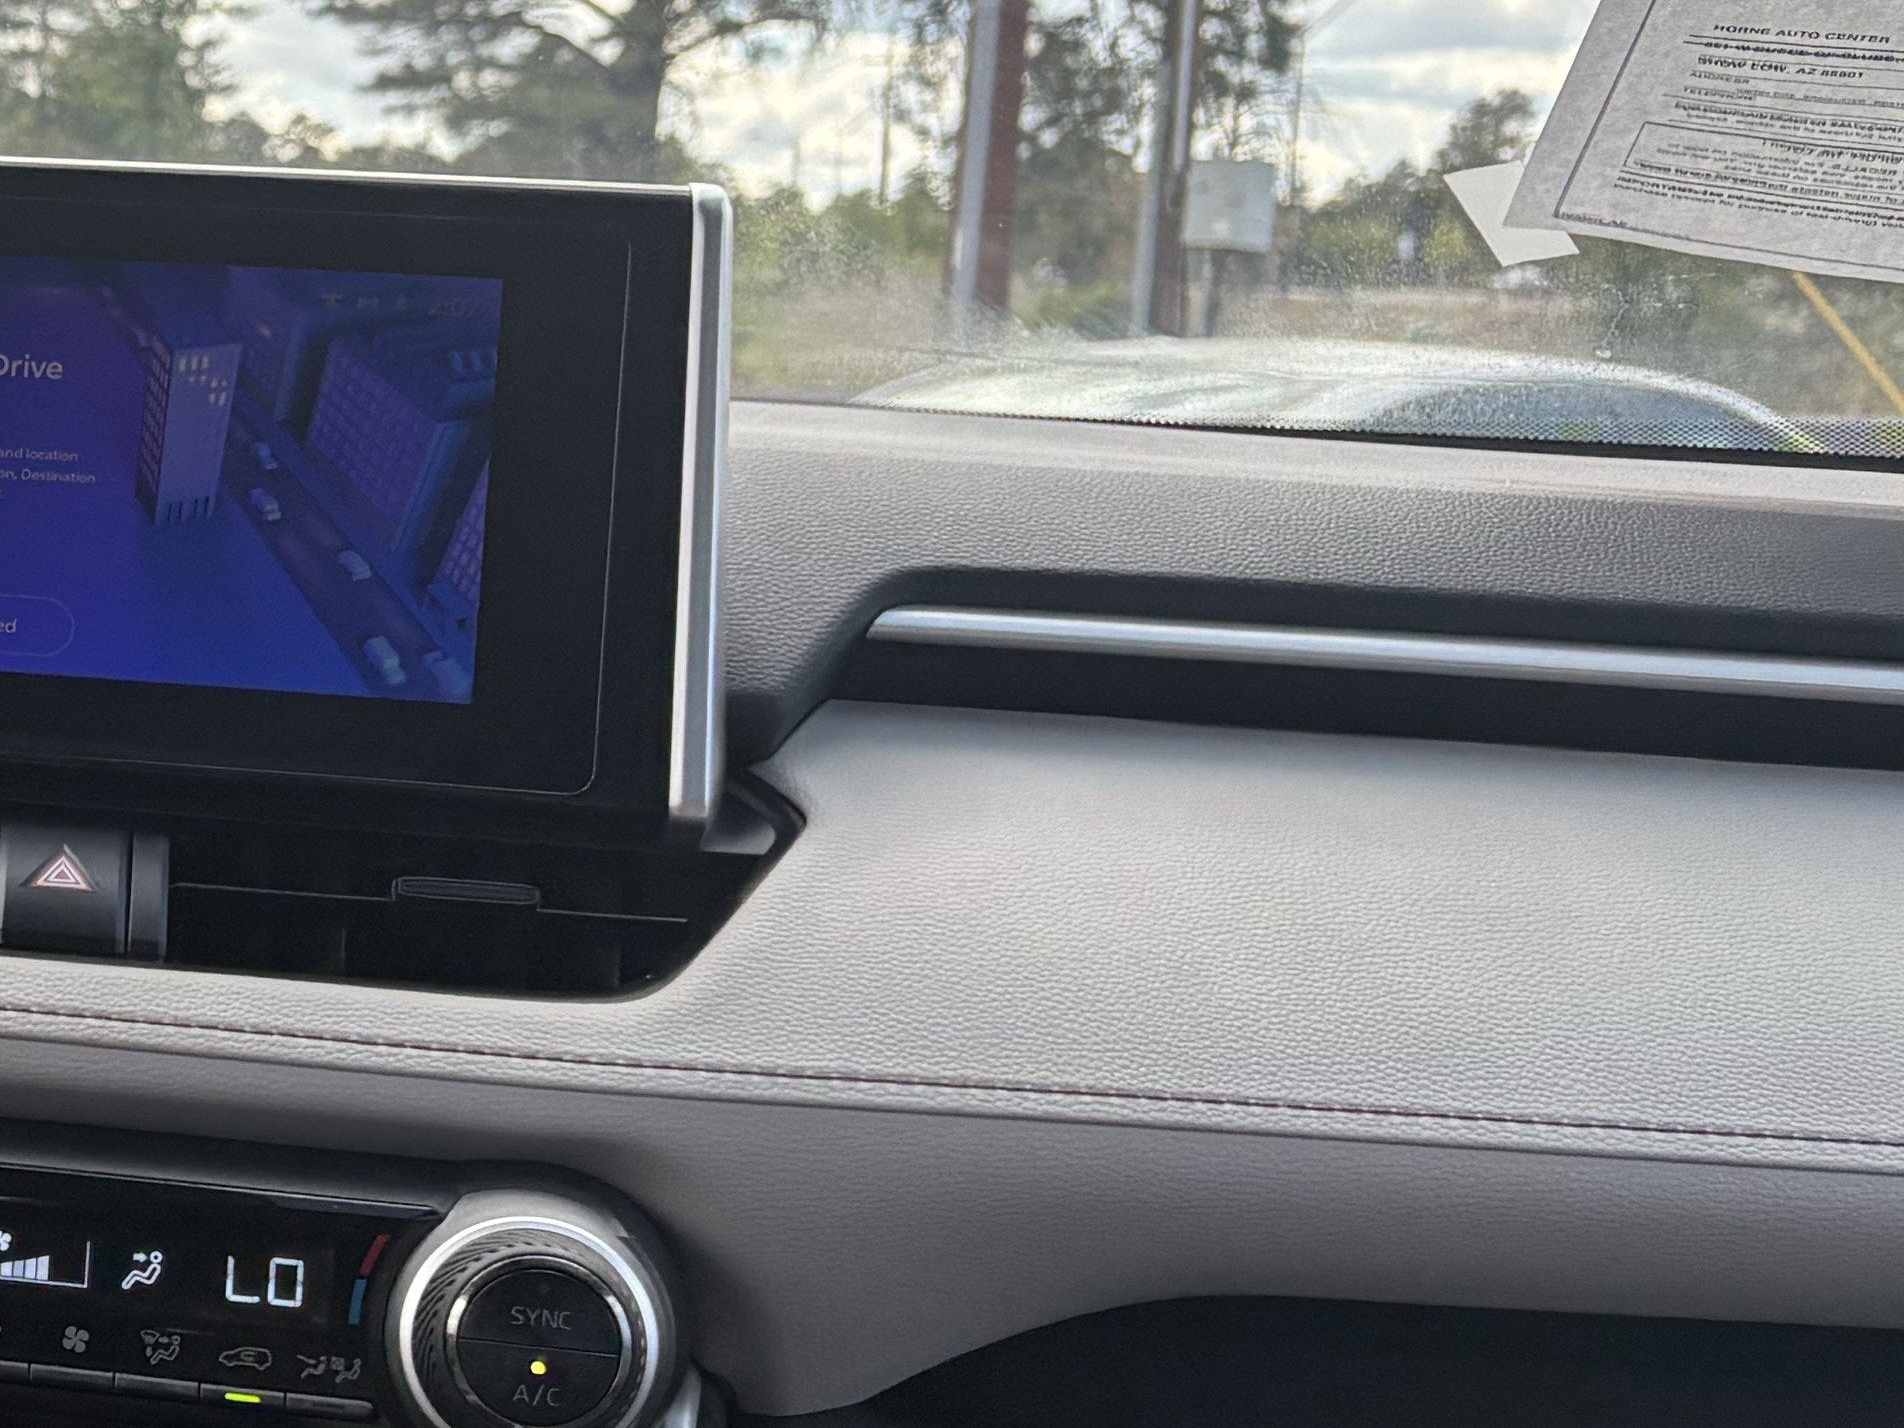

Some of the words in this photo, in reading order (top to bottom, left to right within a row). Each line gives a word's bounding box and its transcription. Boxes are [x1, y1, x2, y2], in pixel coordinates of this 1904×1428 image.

[1713, 24, 1770, 36] HORNE
[1775, 29, 1820, 40] AUTO
[1825, 32, 1891, 44] CENTER
[26, 448, 79, 462] location
[21, 468, 97, 485] Destination
[224, 1255, 305, 1308] LO
[509, 1307, 574, 1330] SYNC
[511, 1384, 561, 1408] A/C
